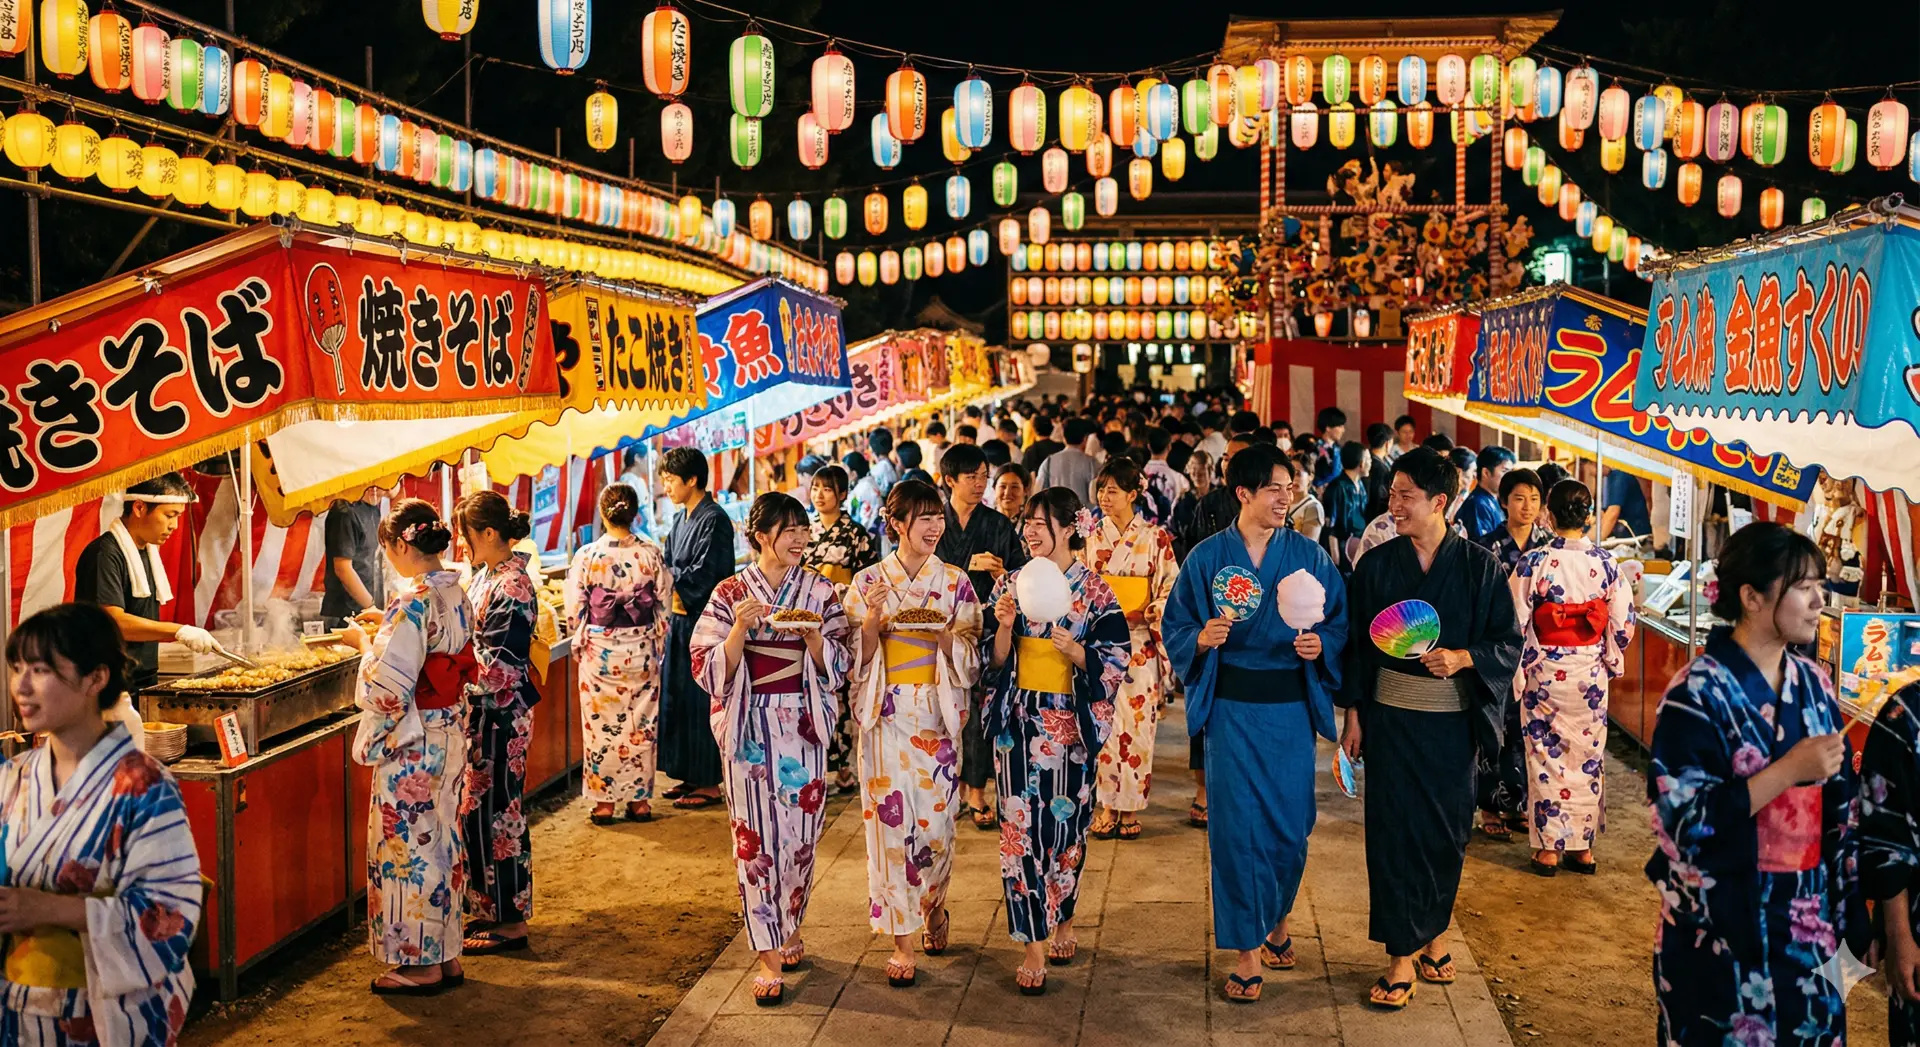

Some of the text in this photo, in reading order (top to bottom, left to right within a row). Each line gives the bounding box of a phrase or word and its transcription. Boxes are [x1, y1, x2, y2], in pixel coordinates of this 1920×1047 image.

[670, 16, 687, 82] たこ焼き
[359, 275, 514, 391] 焼きそば
[605, 304, 684, 393] たこ焼き
